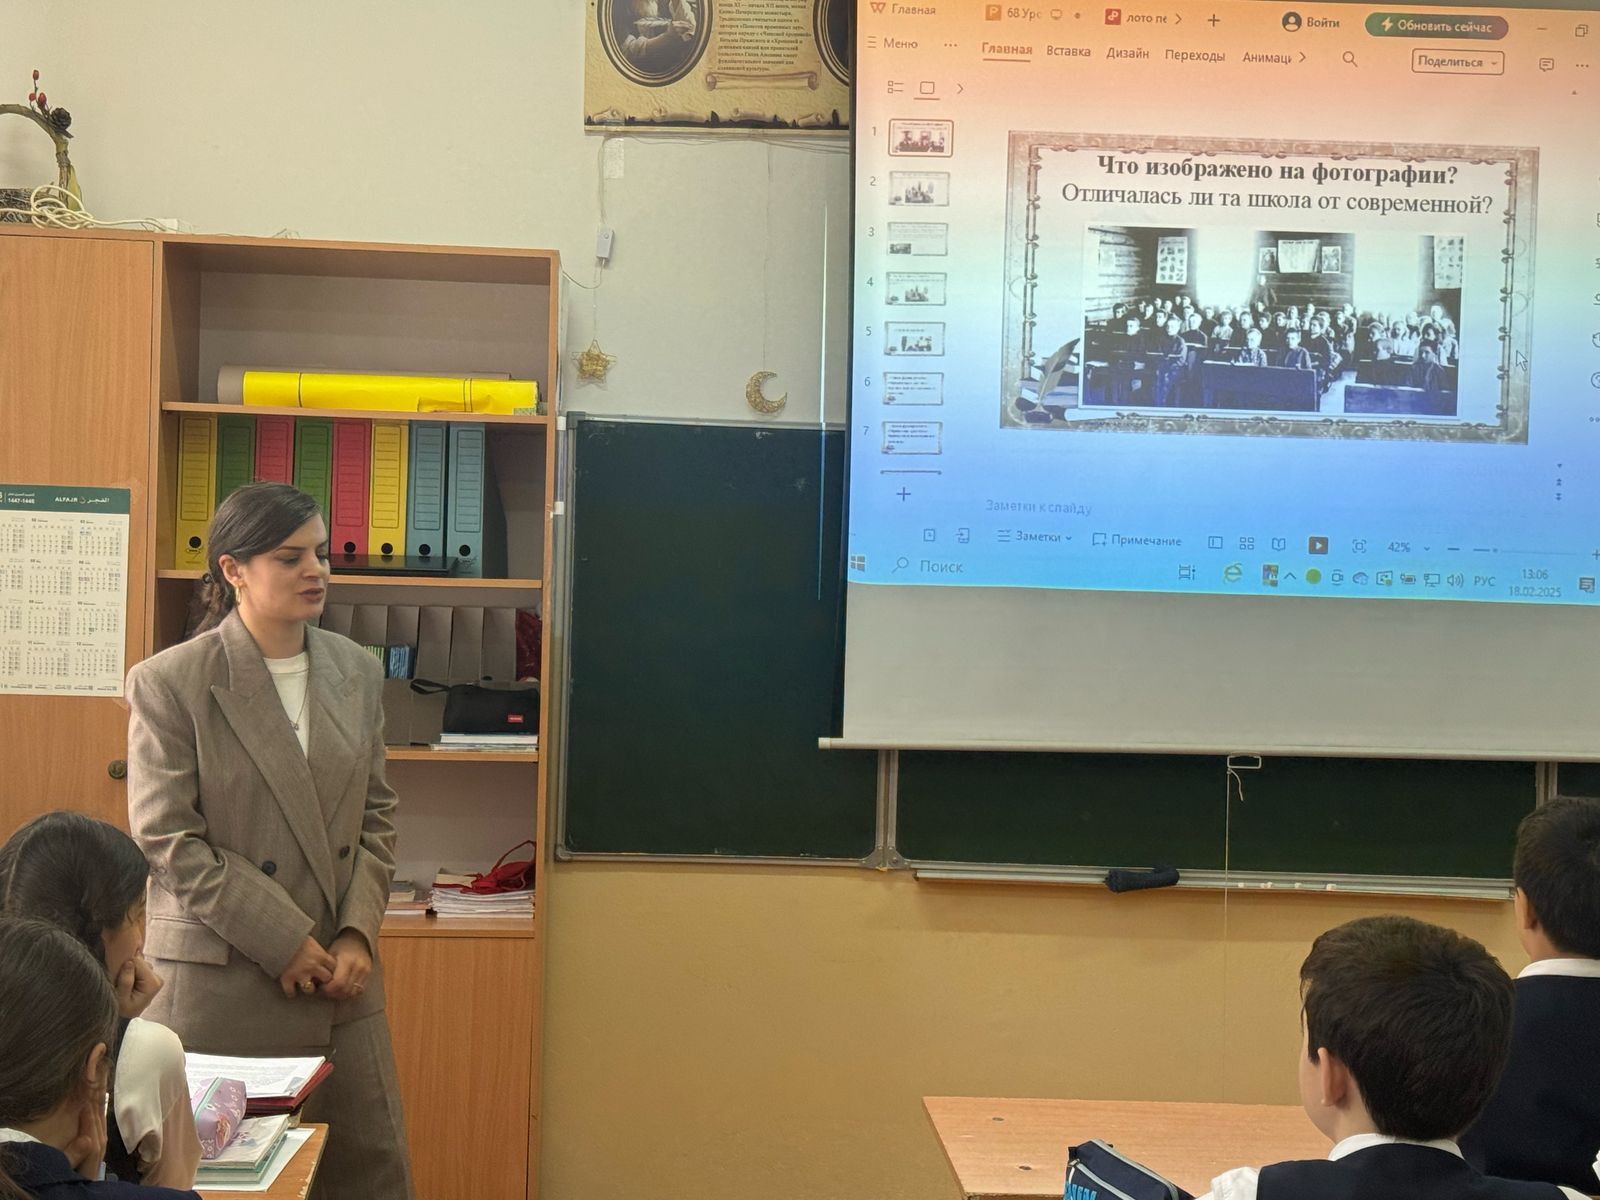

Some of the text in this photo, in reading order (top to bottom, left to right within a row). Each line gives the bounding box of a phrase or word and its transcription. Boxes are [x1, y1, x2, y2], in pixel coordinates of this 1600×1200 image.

[891, 4, 936, 16] Главная
[1007, 8, 1020, 19] 68
[1126, 15, 1153, 25] лото
[1306, 17, 1340, 29] Войти
[1397, 19, 1492, 34] Обновить сейчас
[883, 38, 919, 50] Меню
[982, 42, 1033, 56] Главная
[1046, 45, 1092, 58] Вставка
[1106, 47, 1150, 61] Дизайн
[1164, 49, 1226, 63] Переходы
[1417, 56, 1484, 69] Поделиться
[871, 126, 877, 137] 1
[1097, 155, 1458, 187] Что изображено на фотографии?
[870, 176, 877, 187] 2
[1061, 182, 1494, 216] Отличалась ли та школа от современной?
[868, 227, 875, 237] 3
[866, 277, 874, 287] 4
[866, 326, 872, 336] 5
[864, 376, 871, 387] 6
[862, 426, 870, 436] 7
[986, 499, 1036, 513] Заметки
[1038, 503, 1047, 514] к
[1016, 530, 1061, 543] Заметки
[1112, 534, 1182, 548] Примечание
[1388, 541, 1411, 554] 42%
[920, 560, 963, 573] Поиск
[1522, 568, 1549, 580] 13:06
[1474, 574, 1496, 588] РУС
[1508, 585, 1562, 598] 18.02.2025
